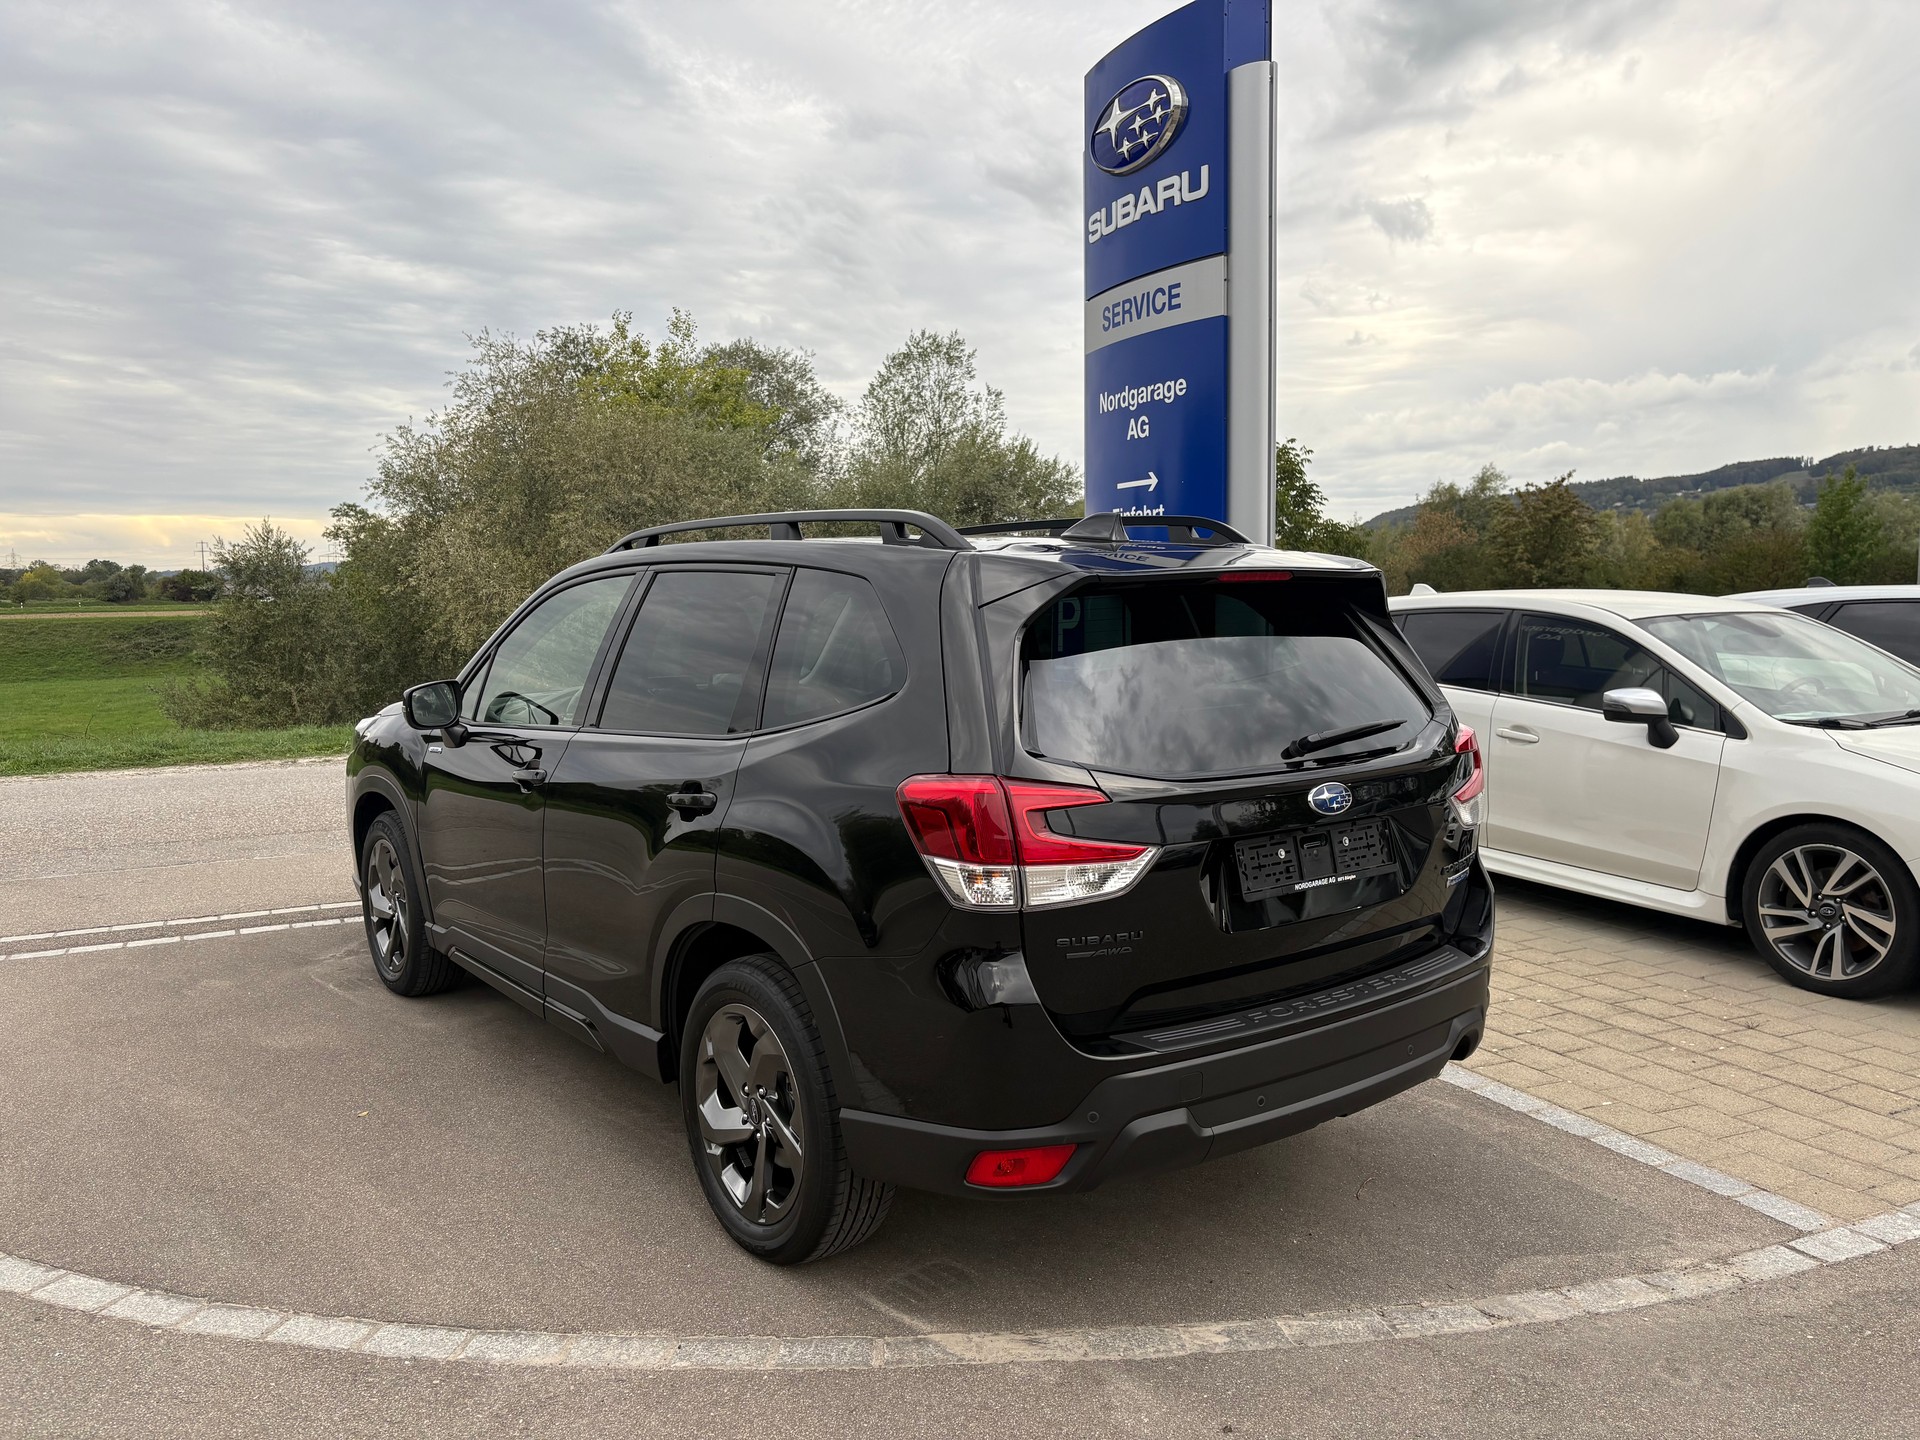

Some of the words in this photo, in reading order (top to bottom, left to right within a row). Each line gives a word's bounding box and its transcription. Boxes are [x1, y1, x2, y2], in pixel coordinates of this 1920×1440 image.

[1088, 164, 1209, 244] SUBARU
[1101, 282, 1182, 332] SERVICE
[1099, 377, 1187, 415] Nordgarage
[1126, 415, 1150, 441] AG
[1112, 504, 1165, 517] fhrt
[1057, 597, 1081, 652] P
[1441, 850, 1476, 875] FOREST
[1294, 877, 1329, 891] NORDGARAGE
[1328, 876, 1336, 884] AG
[1056, 930, 1144, 948] SUBARU
[1092, 946, 1133, 958] AWD
[1245, 972, 1407, 1024] FORESTER
